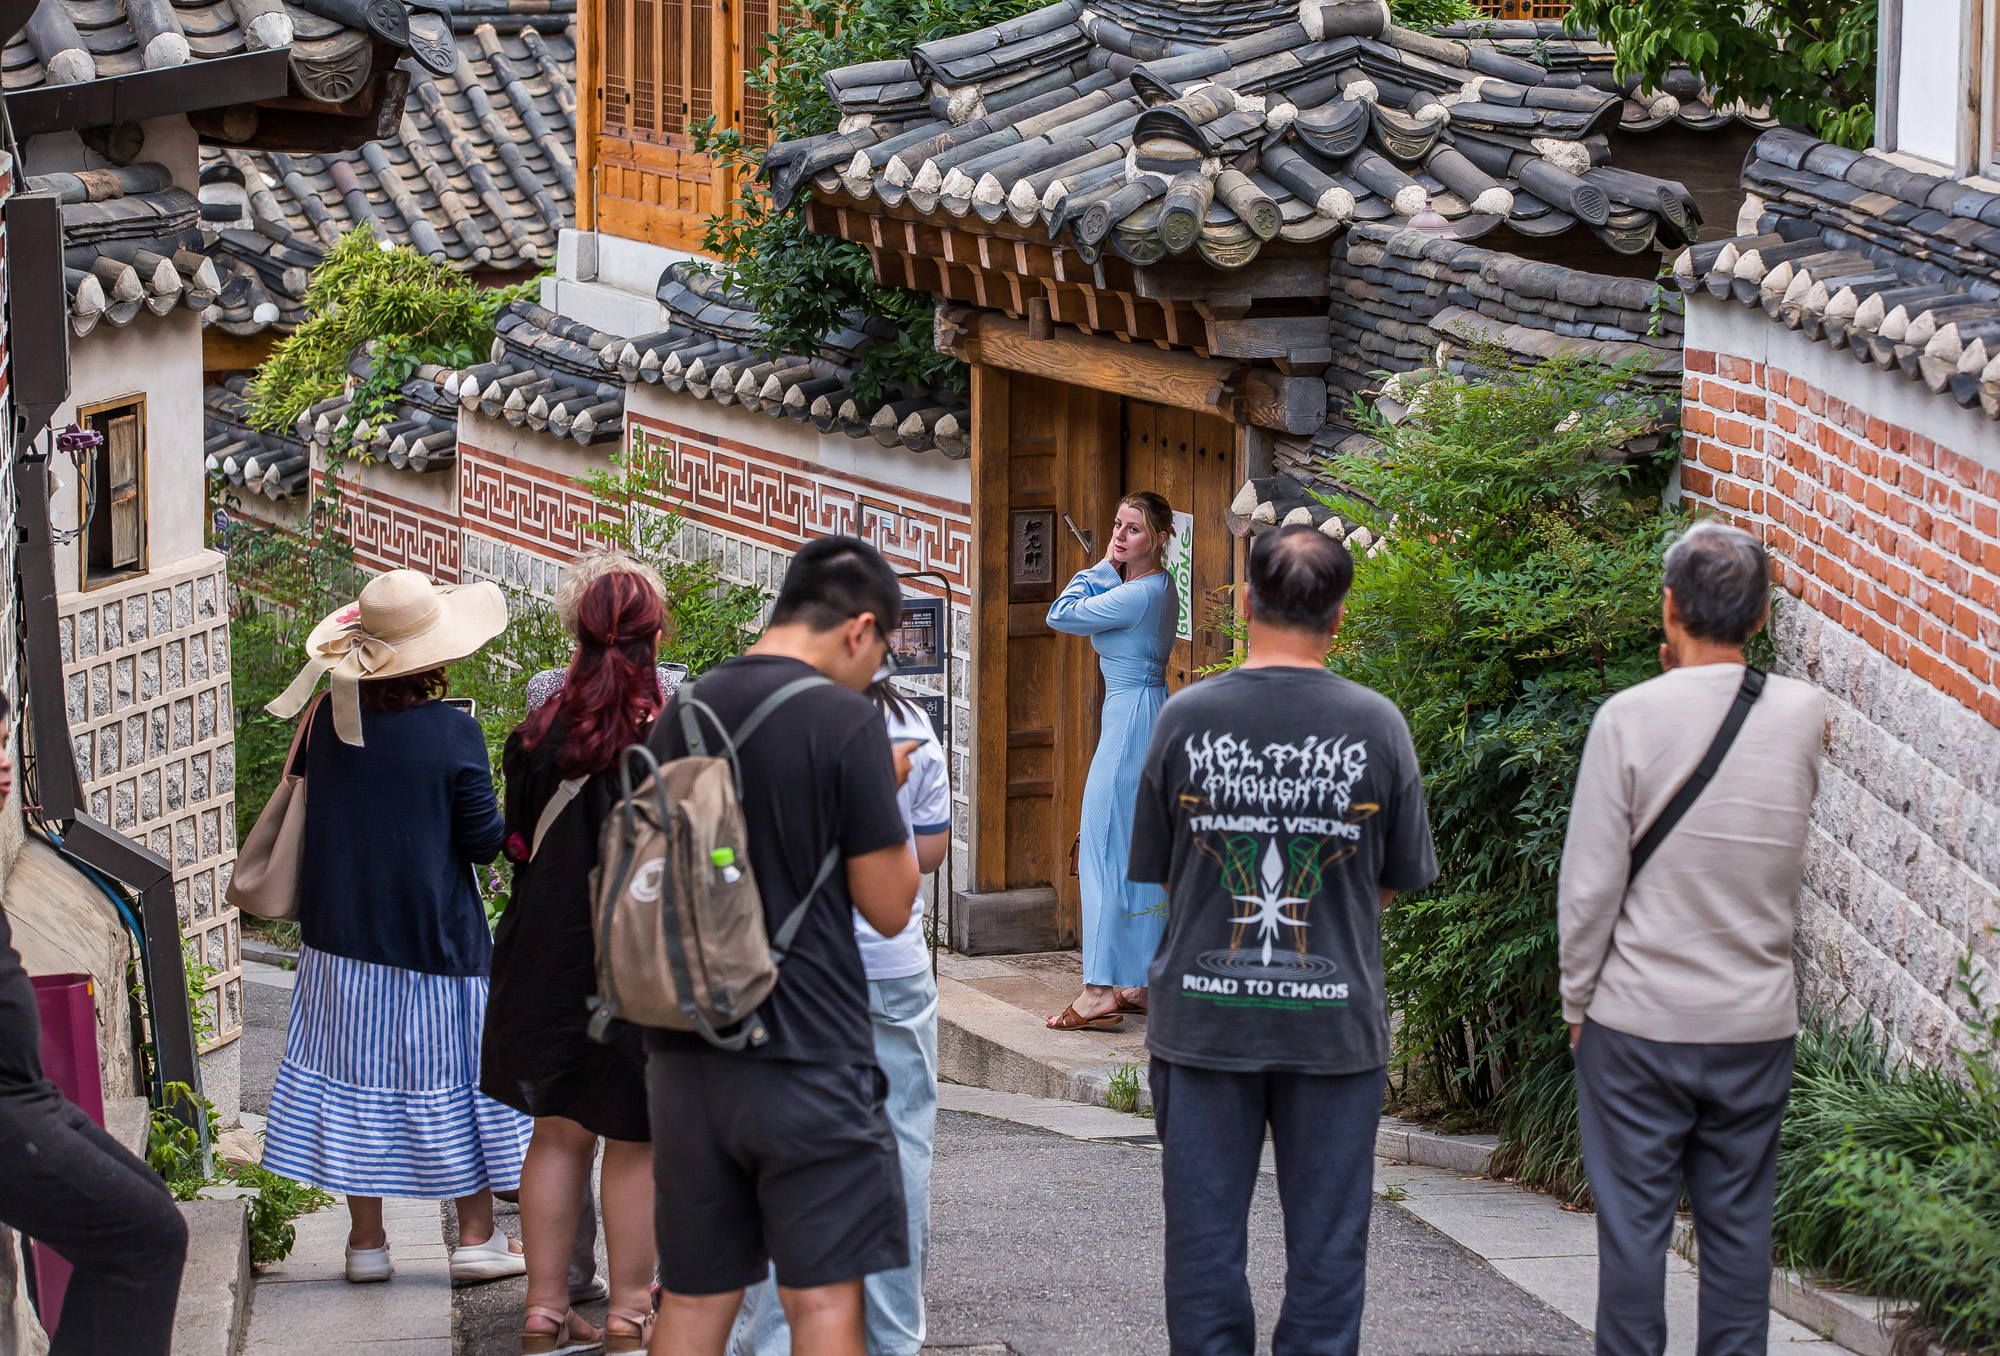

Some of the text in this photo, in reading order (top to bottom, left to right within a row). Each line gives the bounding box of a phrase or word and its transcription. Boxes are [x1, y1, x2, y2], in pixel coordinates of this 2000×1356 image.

[1184, 730, 1368, 785] MELTING
[1201, 774, 1352, 817] THOUGHTS
[1282, 817, 1361, 840] VISIONS
[1182, 974, 1349, 999] ROAD TO CHAOS
